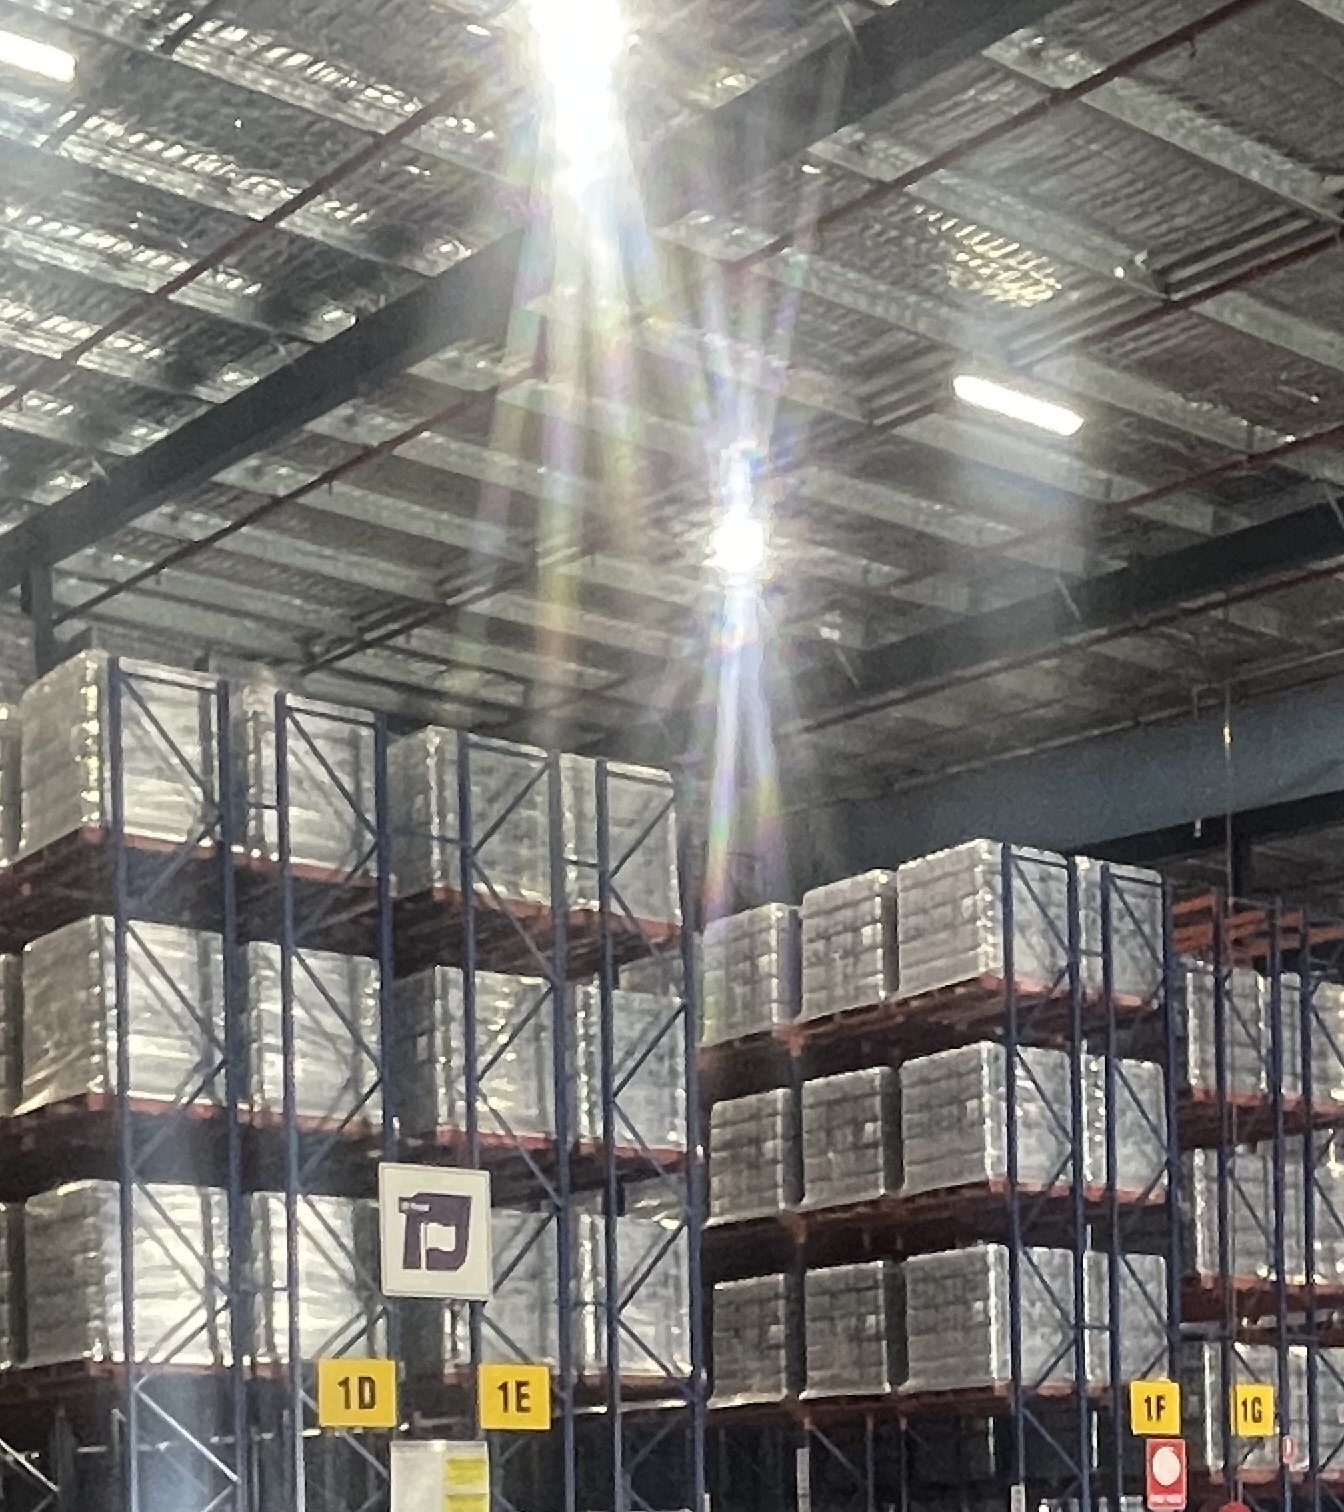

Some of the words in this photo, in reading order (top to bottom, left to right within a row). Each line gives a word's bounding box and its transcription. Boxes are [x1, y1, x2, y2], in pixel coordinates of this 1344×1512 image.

[337, 1376, 376, 1411] 1D
[497, 1380, 531, 1413] 1E
[1144, 1394, 1166, 1422] 1F
[1241, 1396, 1263, 1424] 1G
